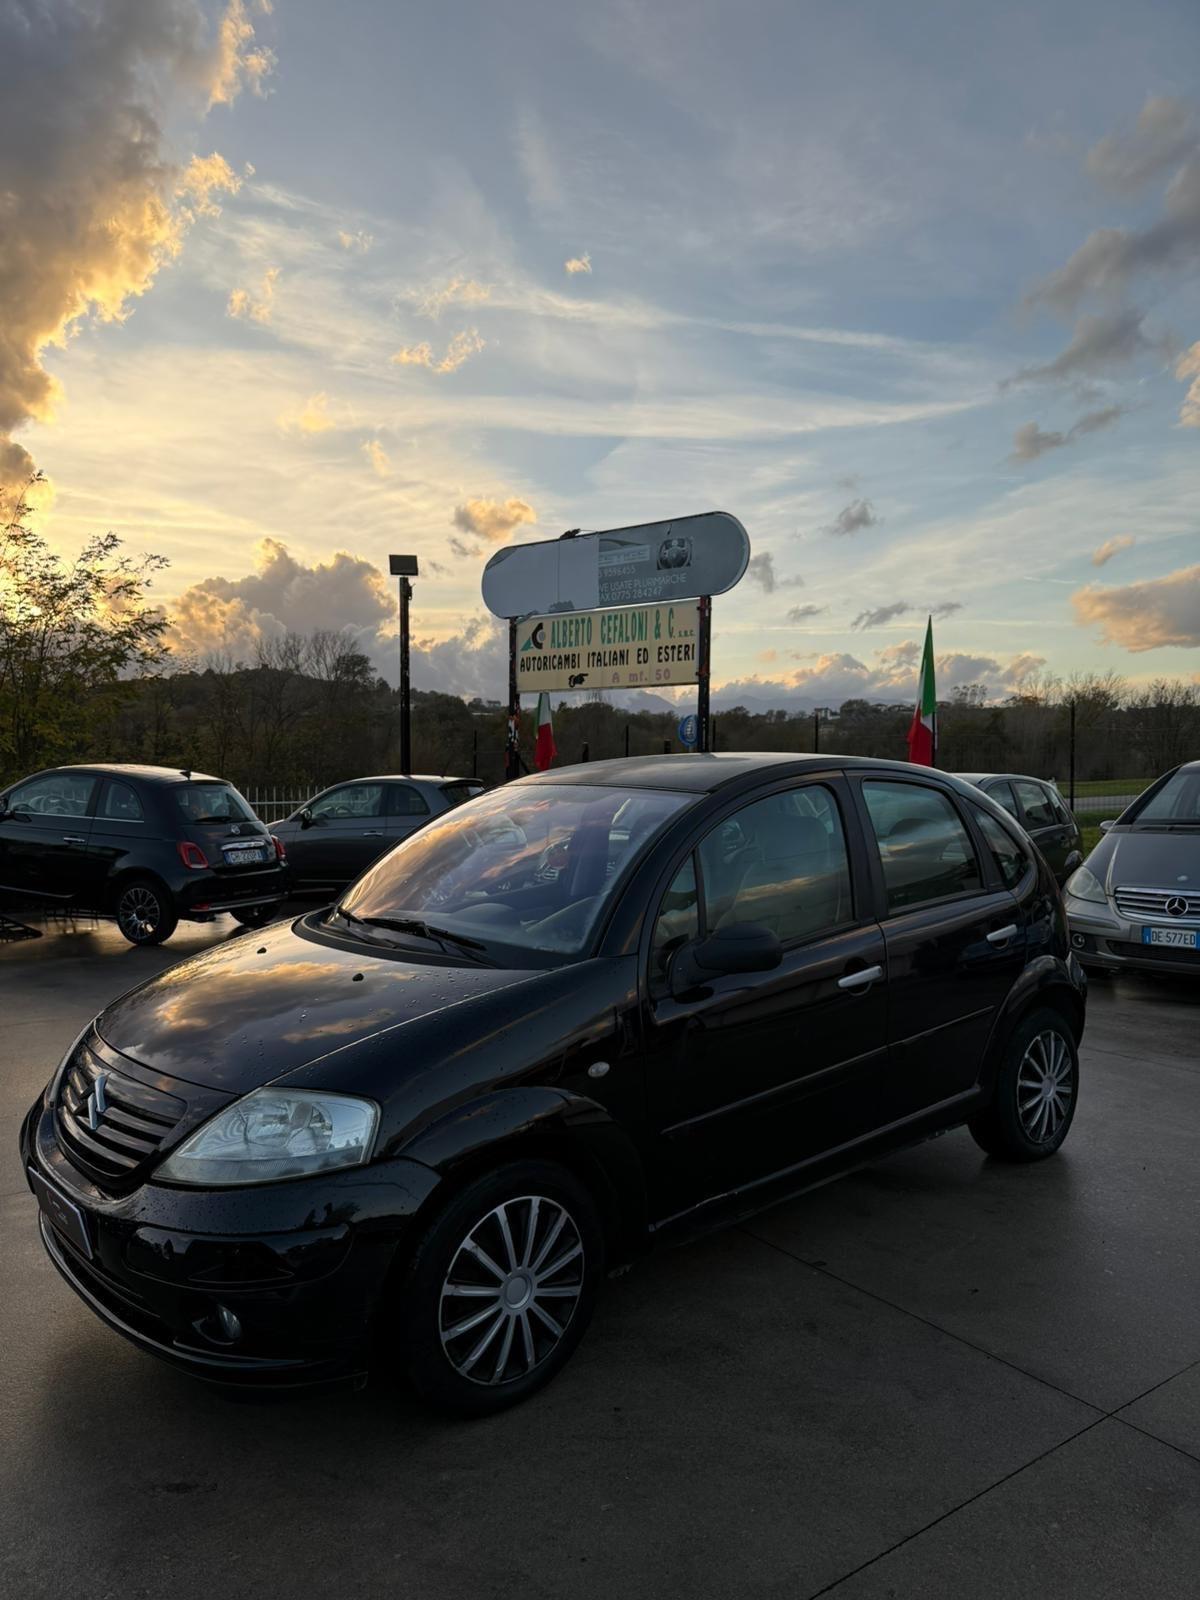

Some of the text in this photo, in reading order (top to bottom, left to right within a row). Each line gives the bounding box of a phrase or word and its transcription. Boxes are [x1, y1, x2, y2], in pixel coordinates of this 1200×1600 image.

[610, 579, 632, 591] USATE
[611, 588, 630, 601] 0775
[550, 616, 593, 649] ALBERTO
[600, 610, 648, 645] CEFALONI
[654, 609, 661, 640] &
[520, 643, 695, 672] AUTORICAMBI ITALIANI ED ESTERI
[655, 668, 671, 681] 50
